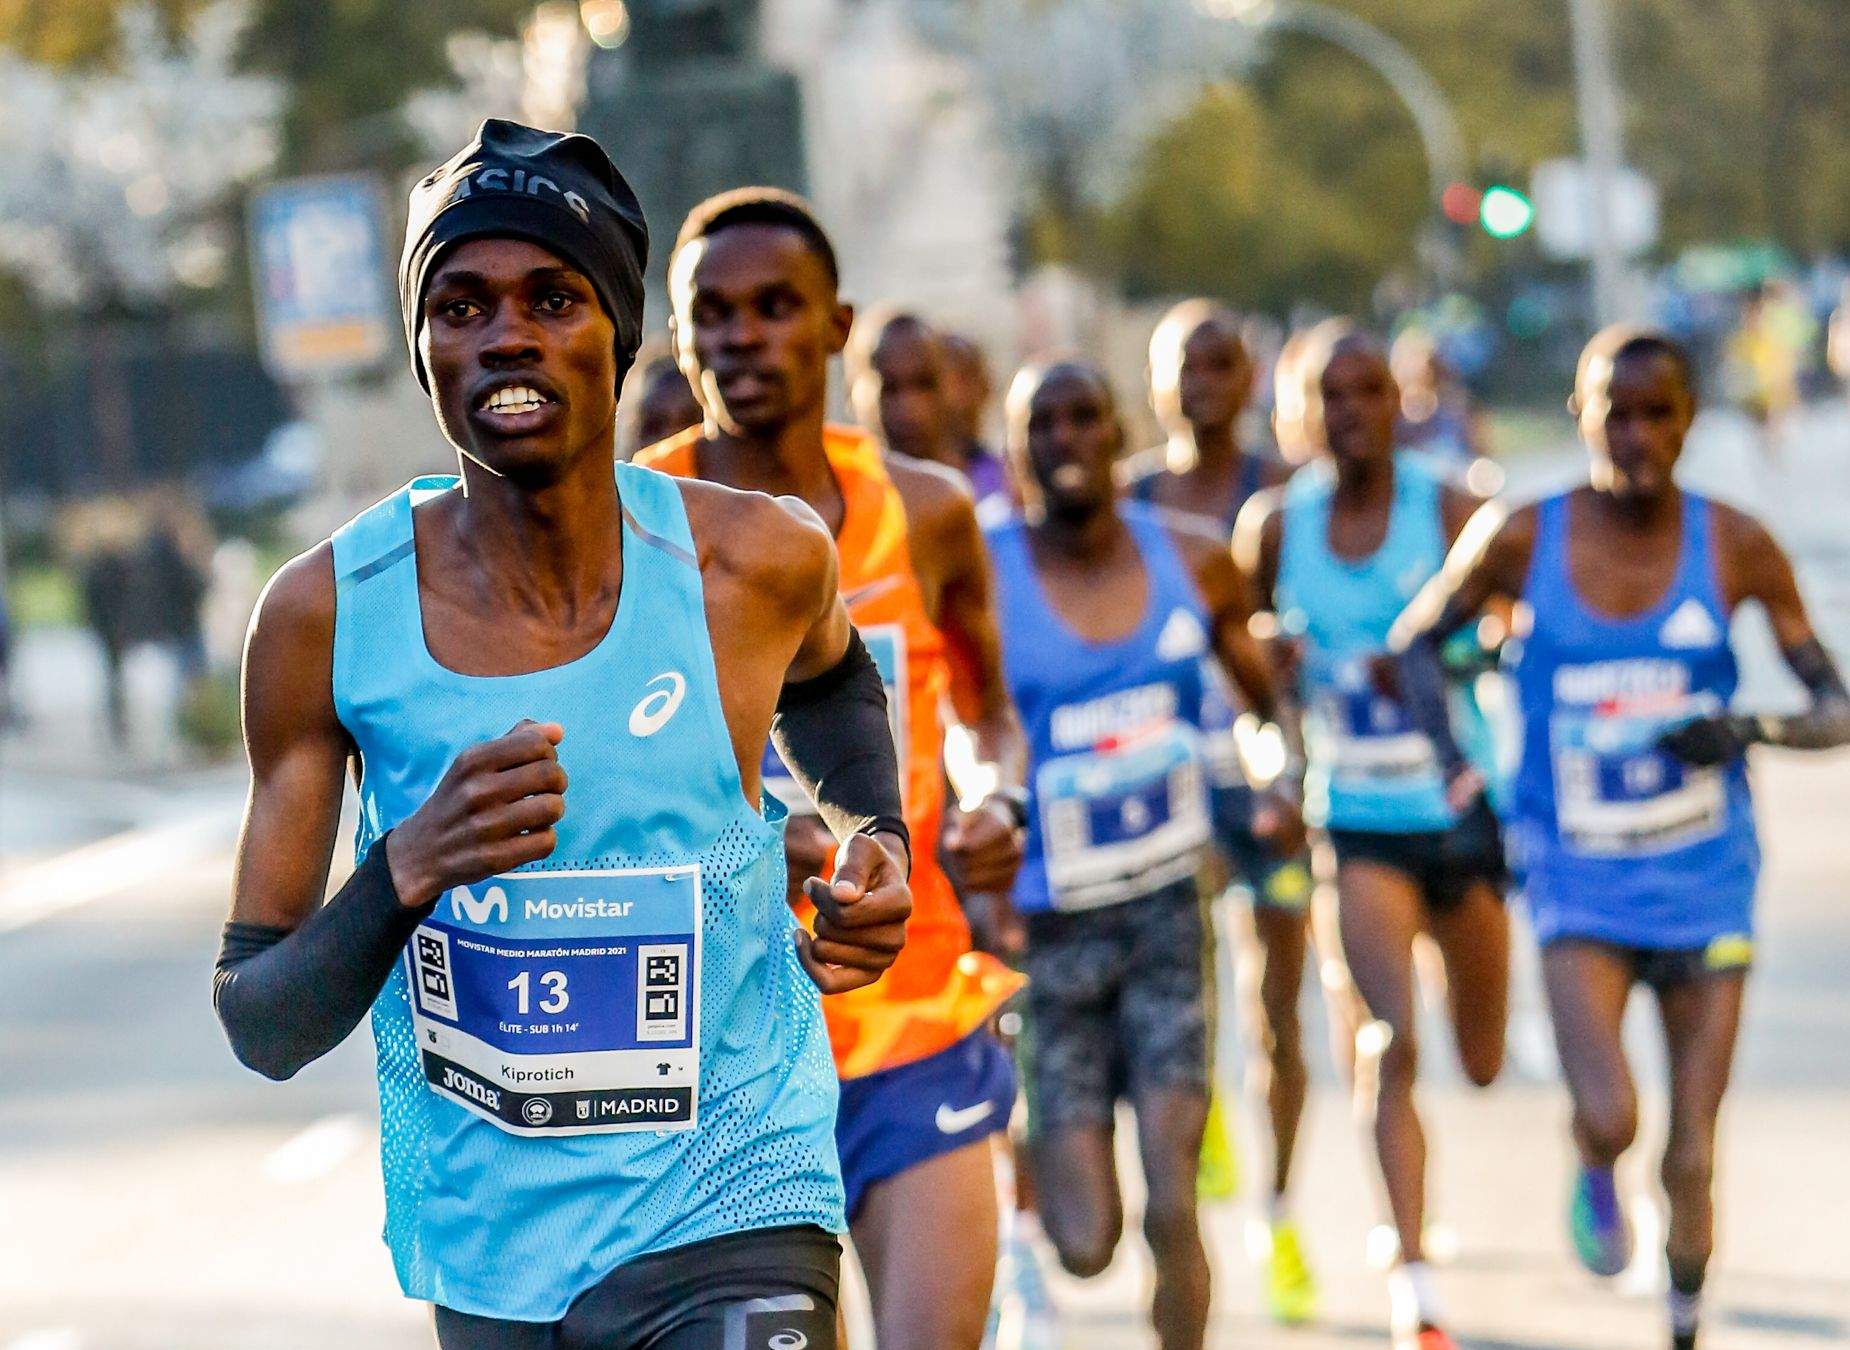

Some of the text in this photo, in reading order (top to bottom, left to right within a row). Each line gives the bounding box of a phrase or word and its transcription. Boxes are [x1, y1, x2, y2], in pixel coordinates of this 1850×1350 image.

[524, 898, 634, 920] Movistar
[457, 939, 627, 958] MOVISTAR MEDIO MARATÓN MADRID 2021
[507, 970, 570, 1015] 13
[529, 1024, 549, 1034] SUB
[551, 1024, 563, 1033] 1h
[501, 1064, 575, 1083] Kiprotich
[601, 1098, 680, 1116] MADRID
